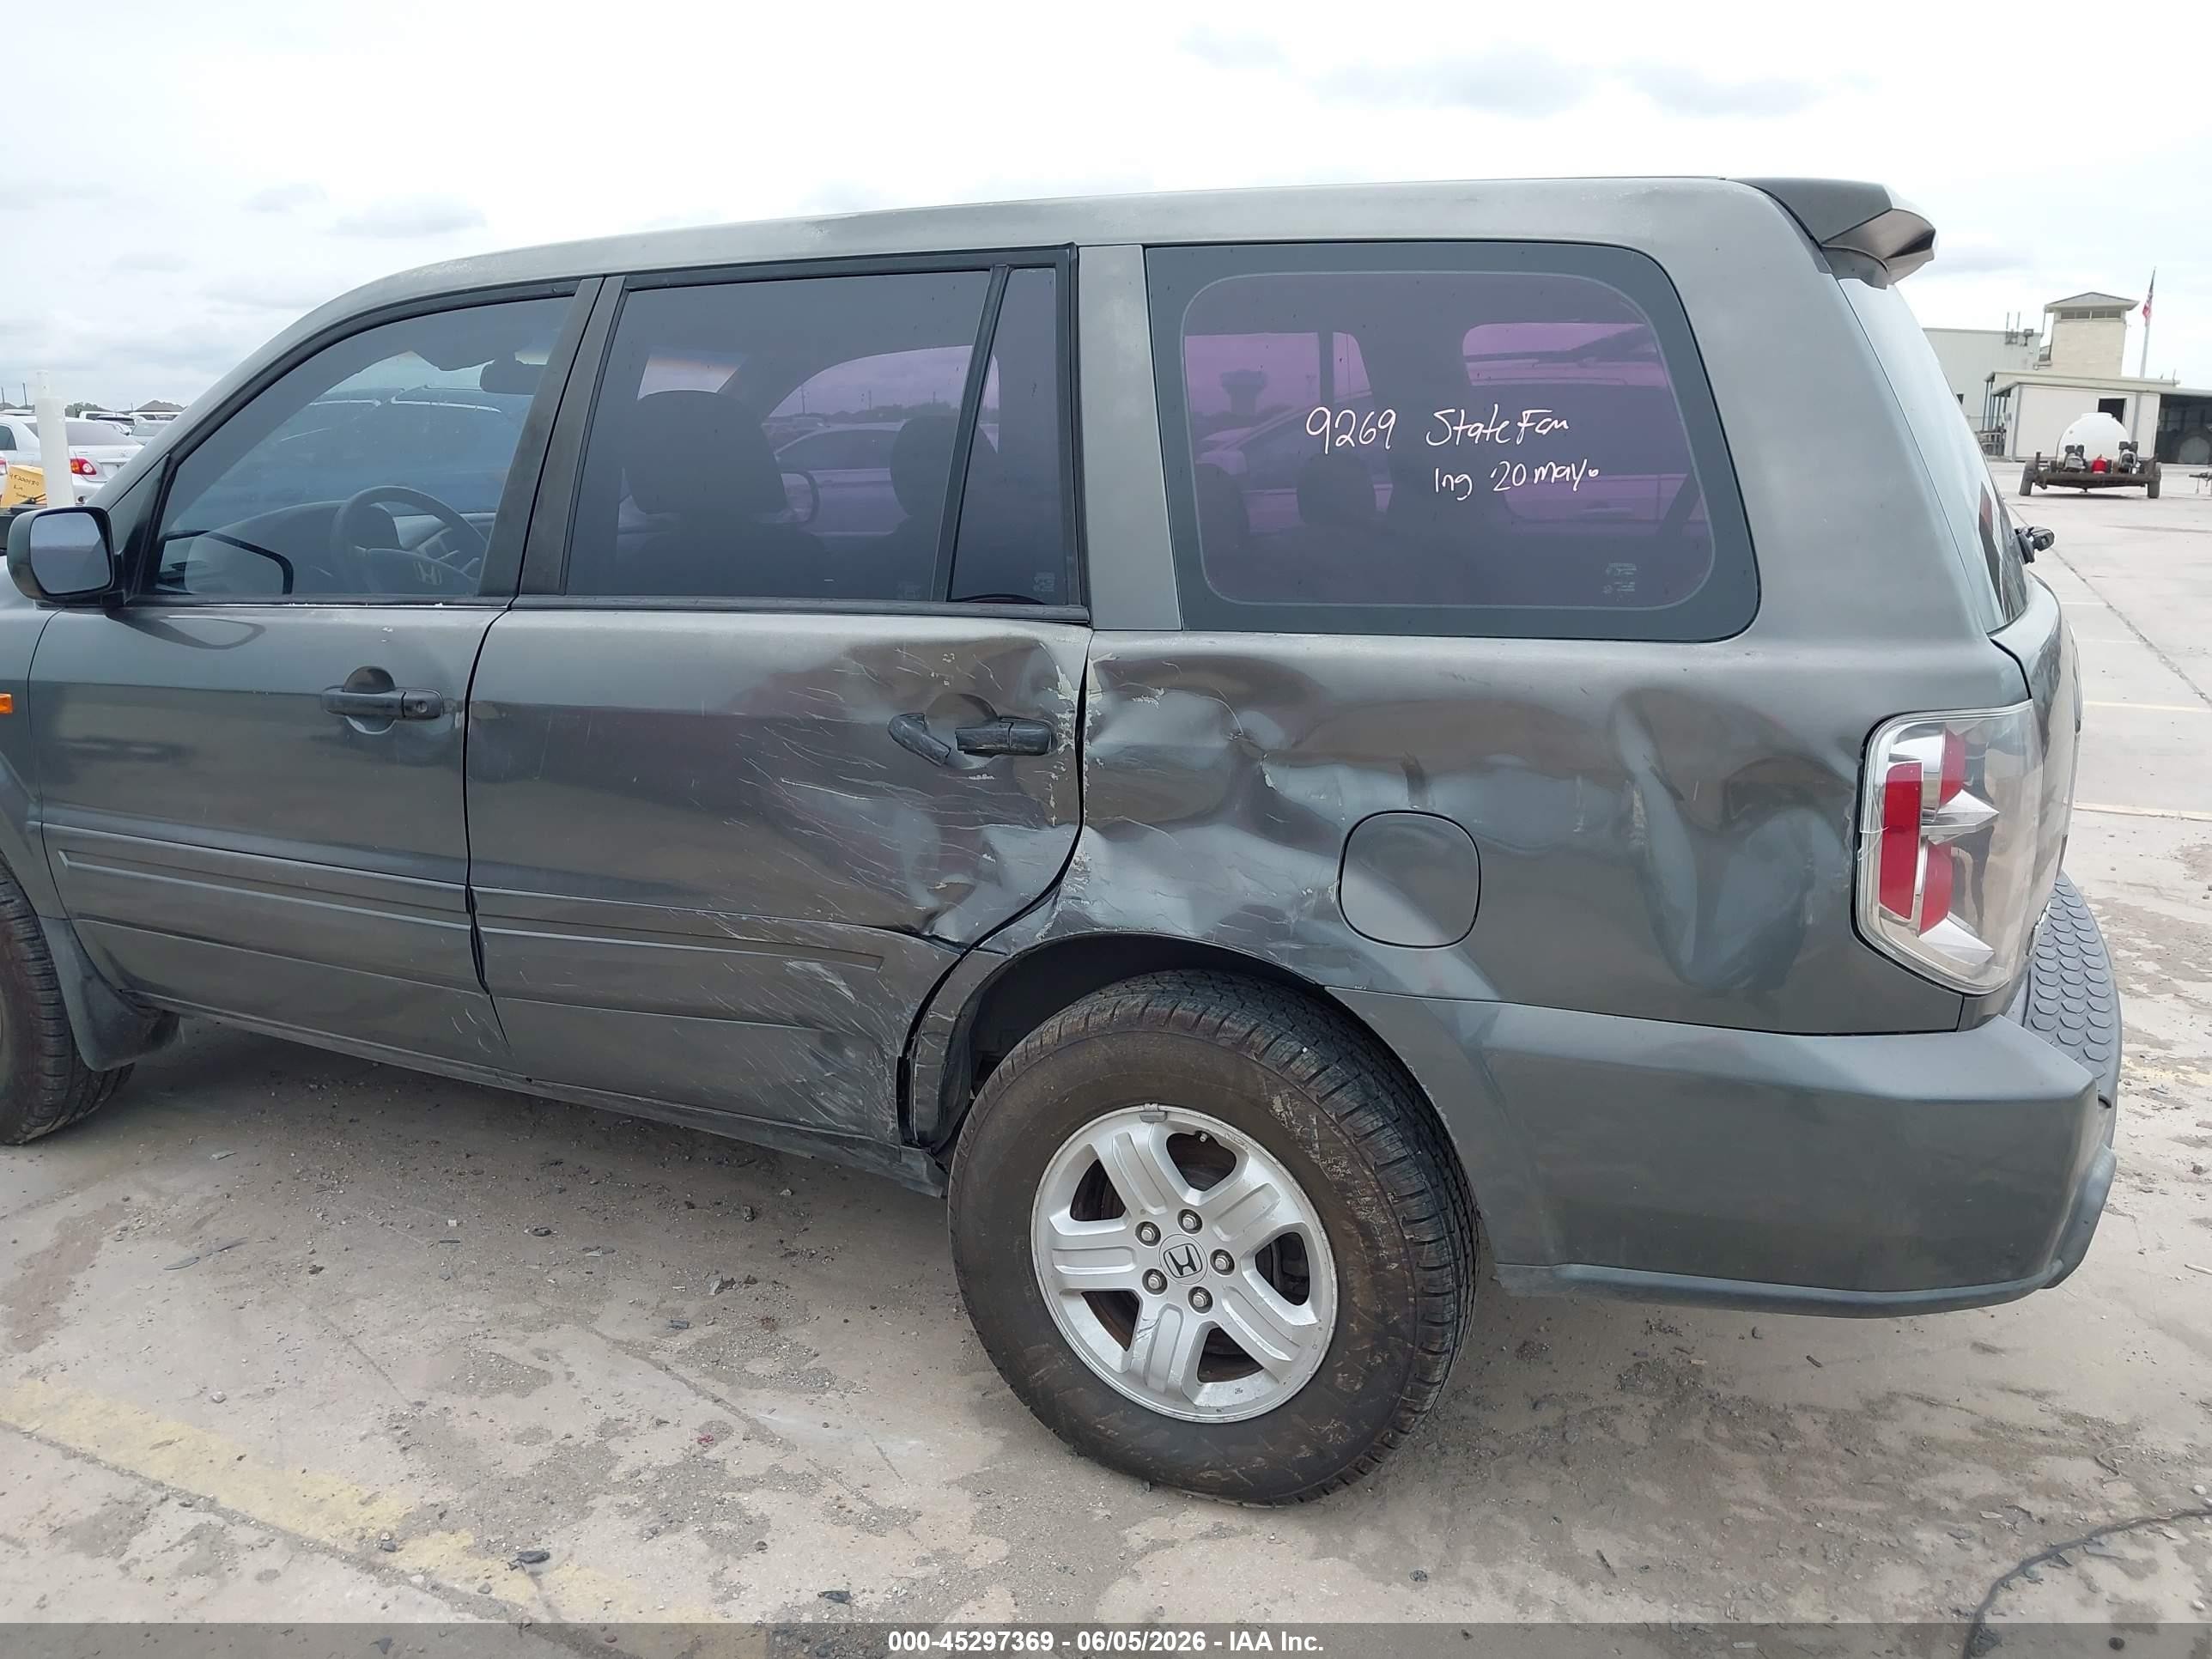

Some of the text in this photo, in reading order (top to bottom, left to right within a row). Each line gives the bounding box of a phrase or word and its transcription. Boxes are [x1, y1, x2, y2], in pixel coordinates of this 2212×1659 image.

[1305, 406, 1397, 454] 9269
[1425, 404, 1511, 446] State
[1490, 460, 1527, 491] 20
